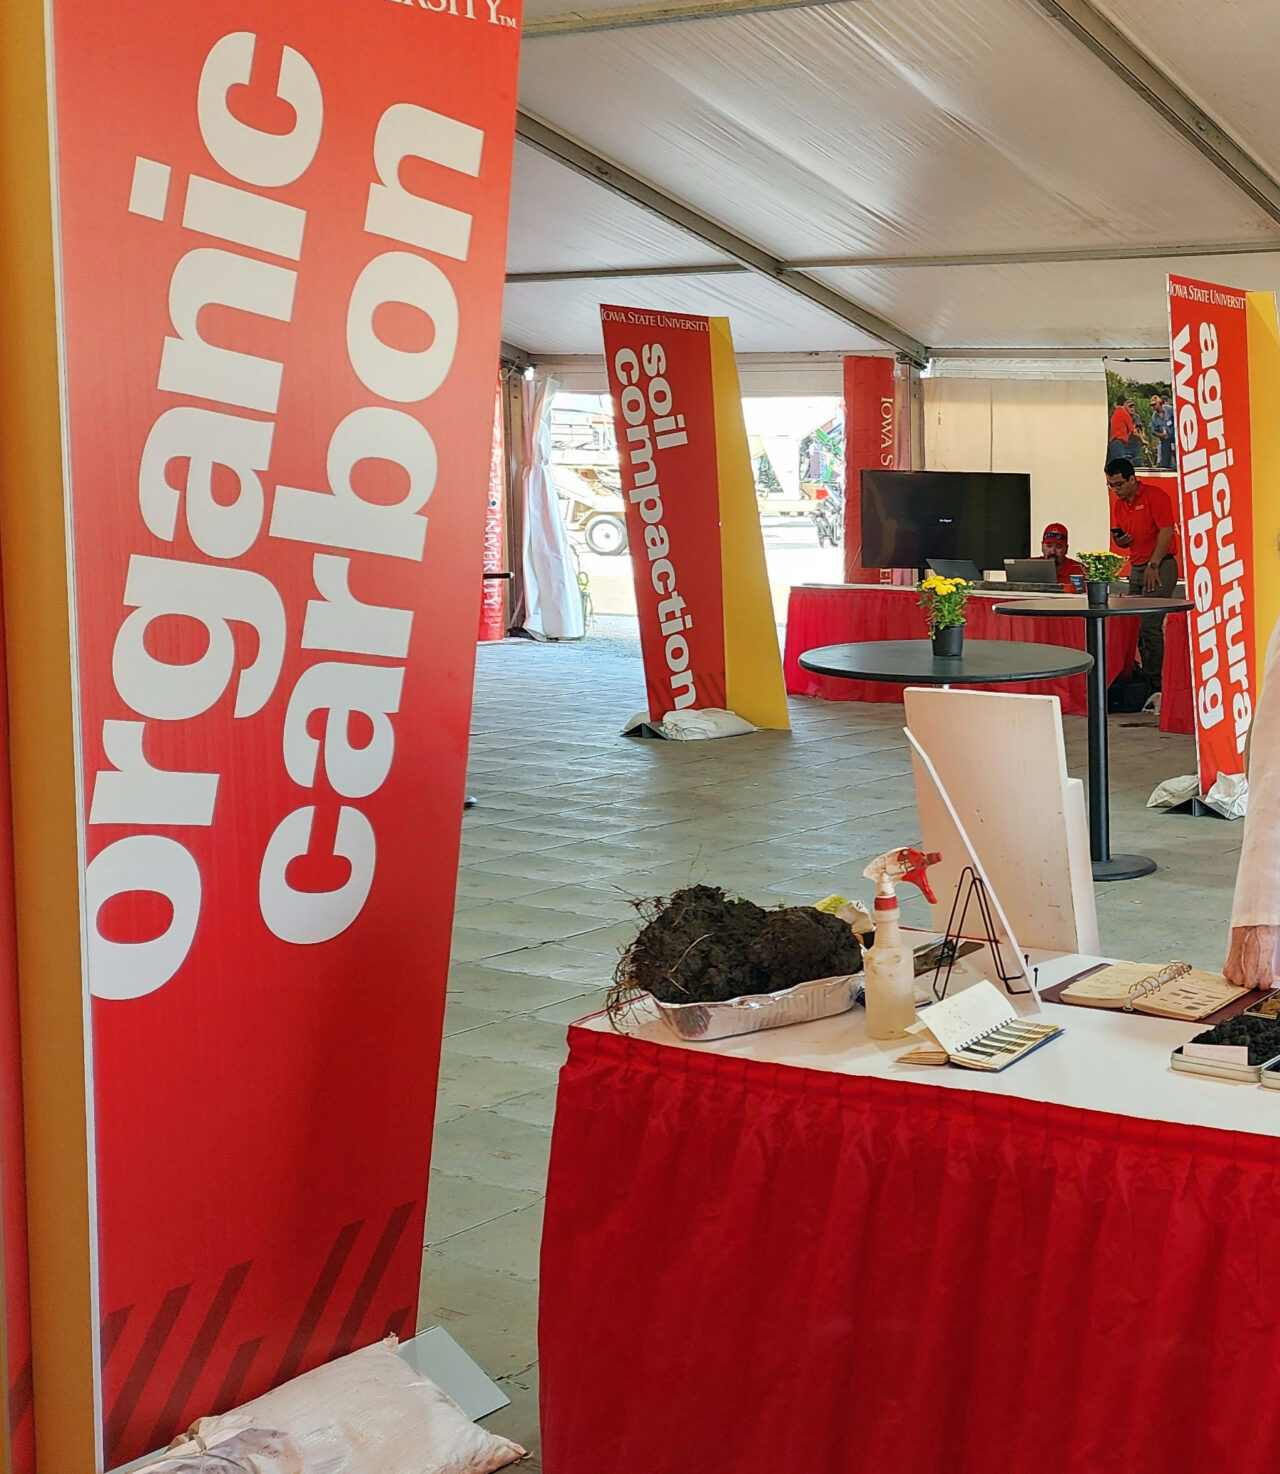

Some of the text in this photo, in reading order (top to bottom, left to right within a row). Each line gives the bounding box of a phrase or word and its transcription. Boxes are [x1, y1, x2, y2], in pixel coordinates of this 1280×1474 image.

[601, 308, 710, 332] IOWA STATE UNIVERSITY
[1169, 281, 1247, 310] IOWA STATE UNIVERSIT
[642, 343, 688, 450] soil
[880, 396, 894, 448] IOWA
[86, 31, 324, 1001] organic
[258, 102, 485, 945] carbon
[484, 506, 498, 606] UNIVERITY
[614, 347, 697, 711] compaction
[1172, 323, 1224, 731] well-being
